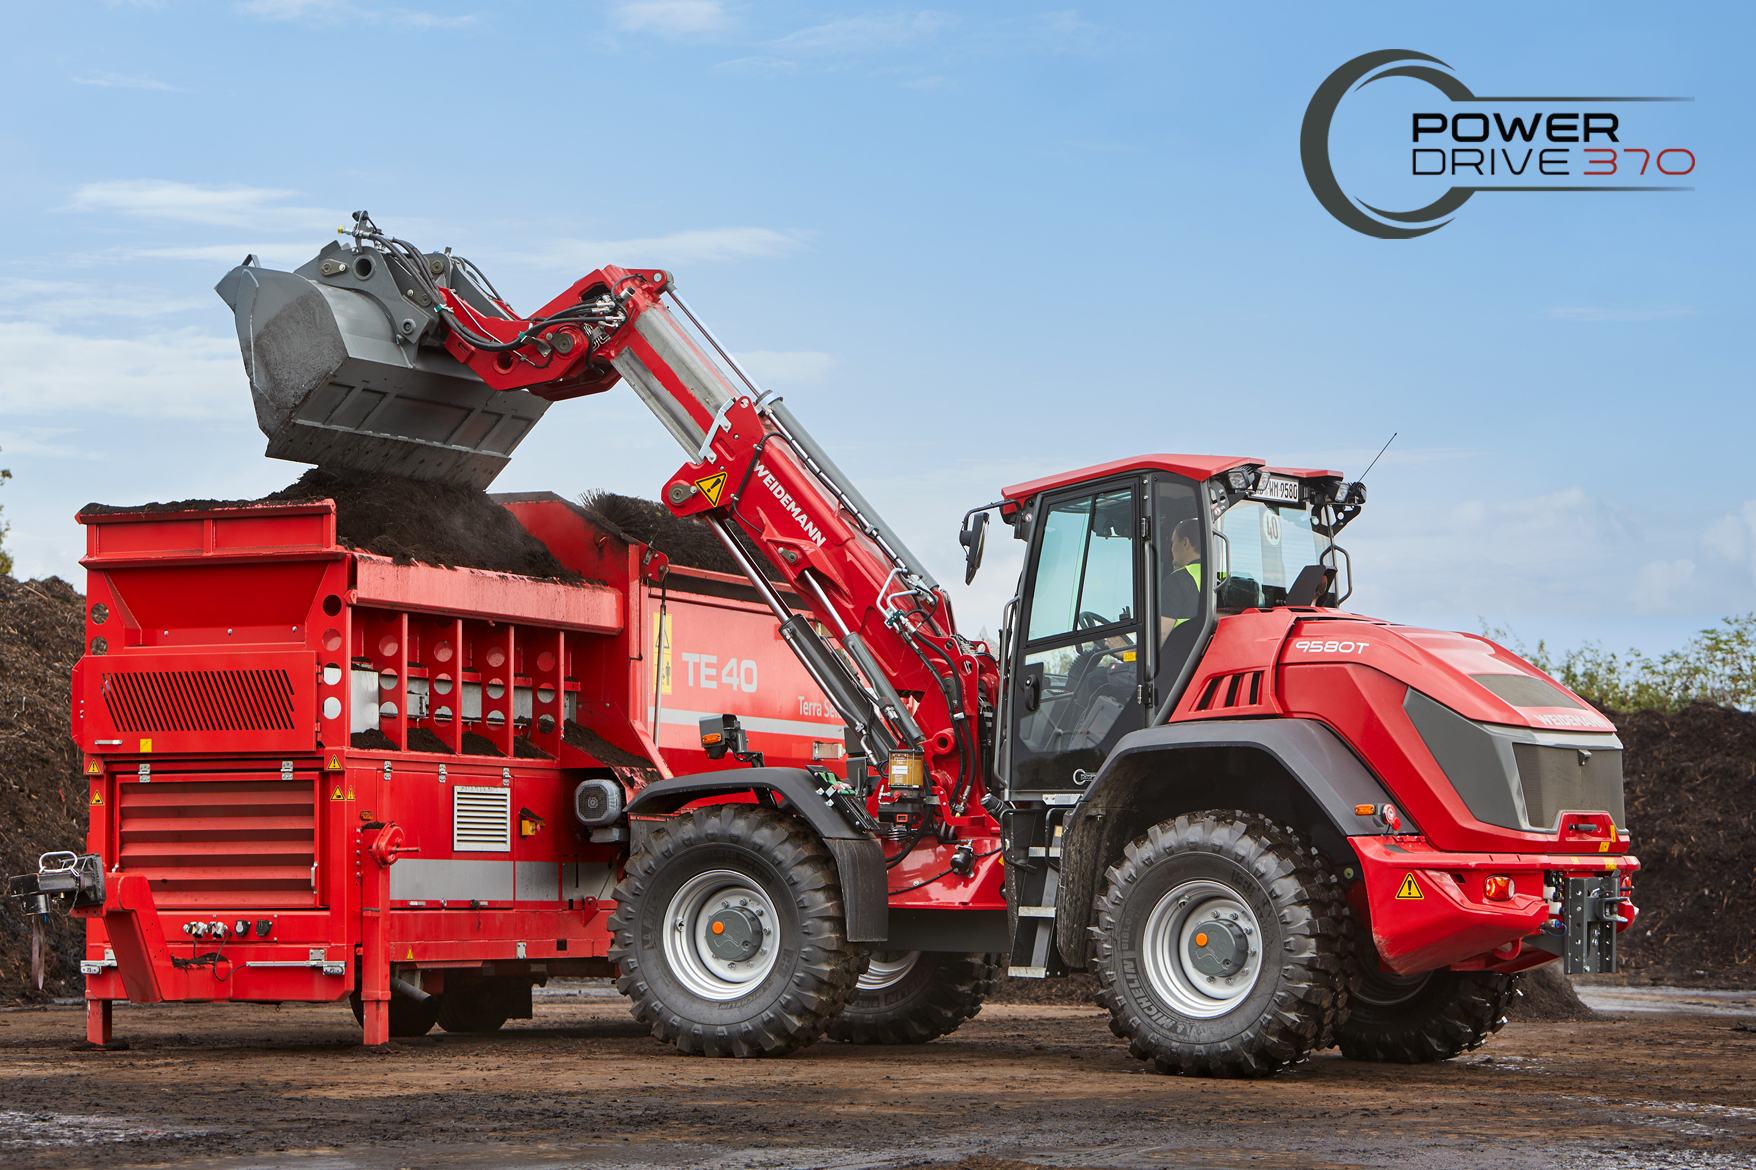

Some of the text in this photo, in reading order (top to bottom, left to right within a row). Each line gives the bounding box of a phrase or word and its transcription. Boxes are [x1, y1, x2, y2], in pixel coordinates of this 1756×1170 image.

[754, 459, 827, 547] WEIDEMANN
[1266, 515, 1279, 539] 40
[1296, 641, 1370, 654] 9580T
[682, 652, 758, 693] TE 40
[798, 696, 822, 717] Terra
[1533, 714, 1609, 729] WEIDEMANN
[1123, 959, 1177, 1031] MICHELIN
